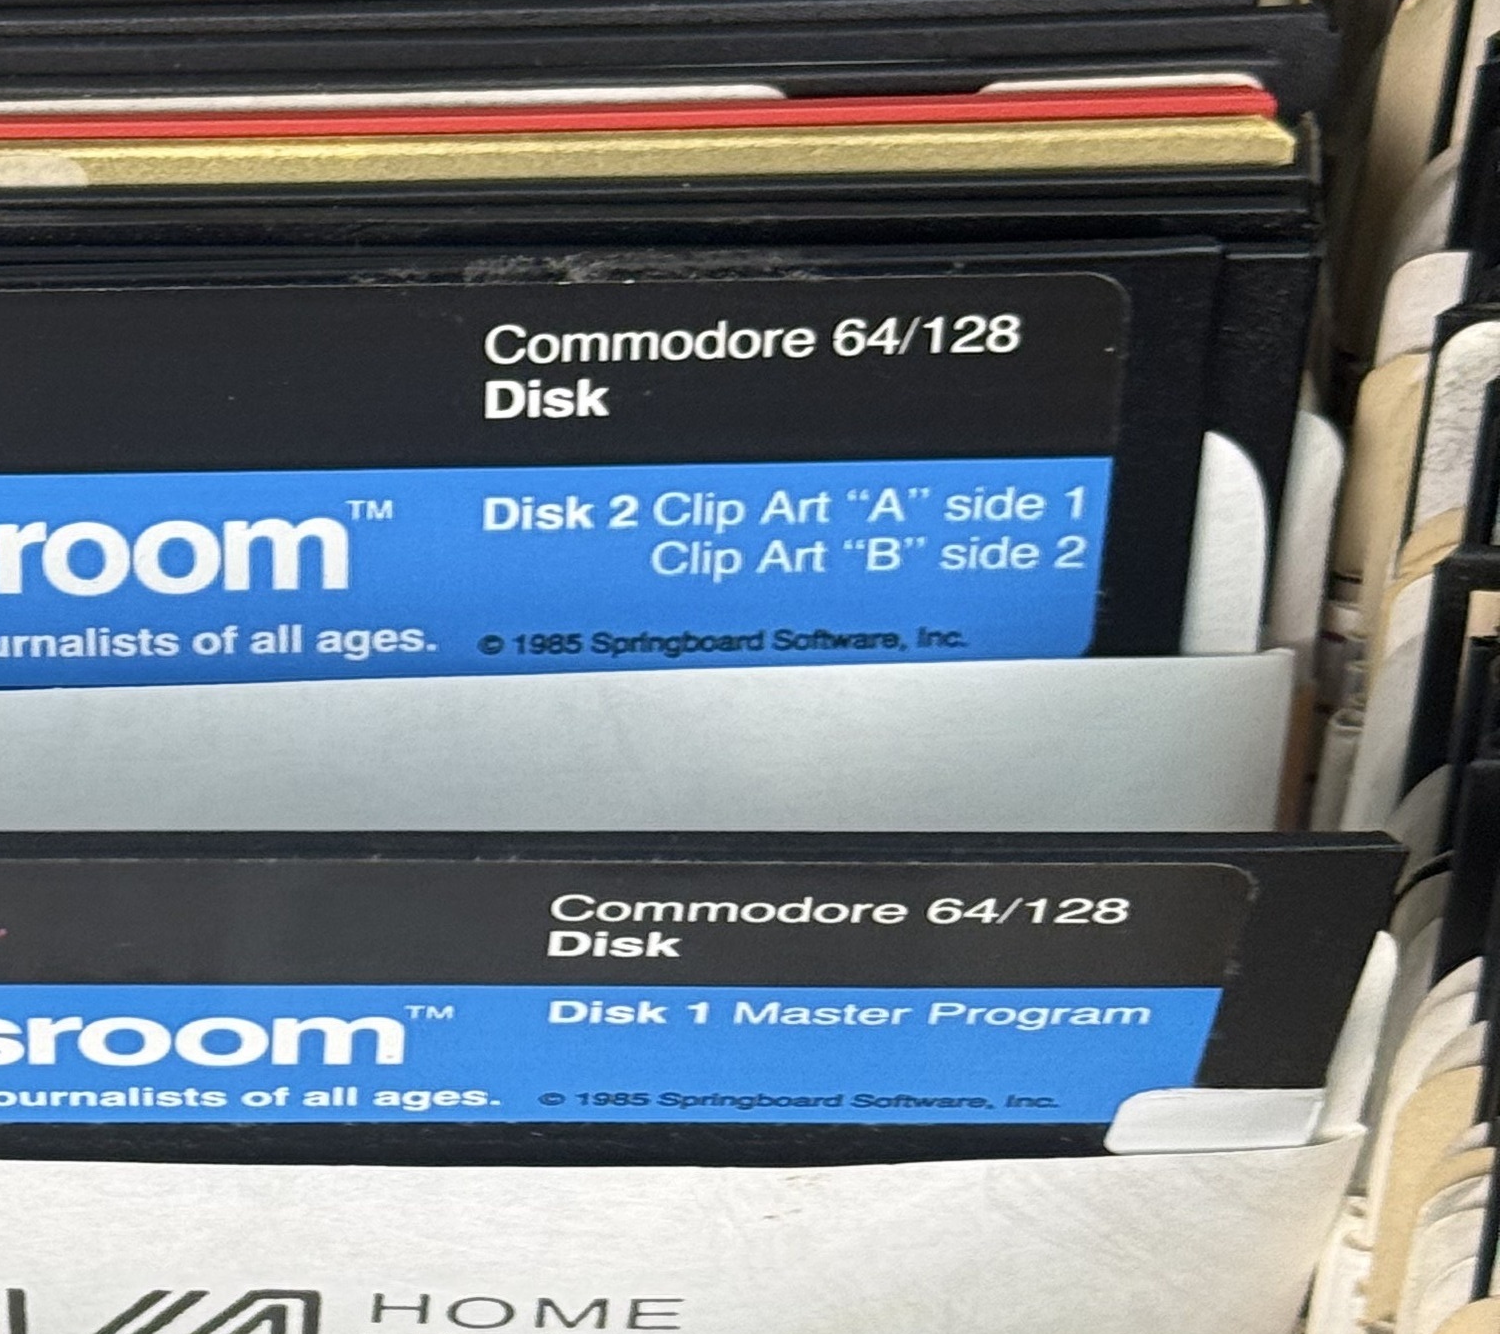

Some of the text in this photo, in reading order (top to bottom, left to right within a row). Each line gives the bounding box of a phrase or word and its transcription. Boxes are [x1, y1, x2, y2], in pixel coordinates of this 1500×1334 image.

[484, 315, 1021, 365] Commodore 64/128
[484, 378, 610, 420] Disk
[483, 496, 594, 531] Disk
[607, 495, 638, 528] 2
[653, 492, 746, 534] Clip
[759, 491, 831, 524] Art
[944, 486, 1046, 520] side
[1063, 487, 1085, 519] 1
[651, 541, 743, 583] Clip
[756, 540, 827, 573] Art
[940, 536, 1041, 569] side
[1055, 536, 1088, 568] 2
[192, 625, 238, 656] of
[250, 624, 302, 654] all
[316, 628, 436, 661] ages.
[513, 633, 583, 655] 1985
[590, 629, 765, 658] Springboard
[772, 628, 908, 653] Software,
[917, 626, 968, 649] Inc.
[549, 894, 1131, 924] Commodore 64/128
[547, 931, 681, 958] Disk
[548, 1000, 1152, 1031] Disk 1 Master Program
[240, 1085, 291, 1107] of
[302, 1086, 358, 1107] all
[372, 1089, 501, 1111] ages.
[577, 1091, 650, 1107] 1985
[657, 1091, 843, 1111] Springboard
[850, 1093, 995, 1110] Software,
[1005, 1094, 1060, 1109] Inc.
[371, 1293, 686, 1329] HOME
